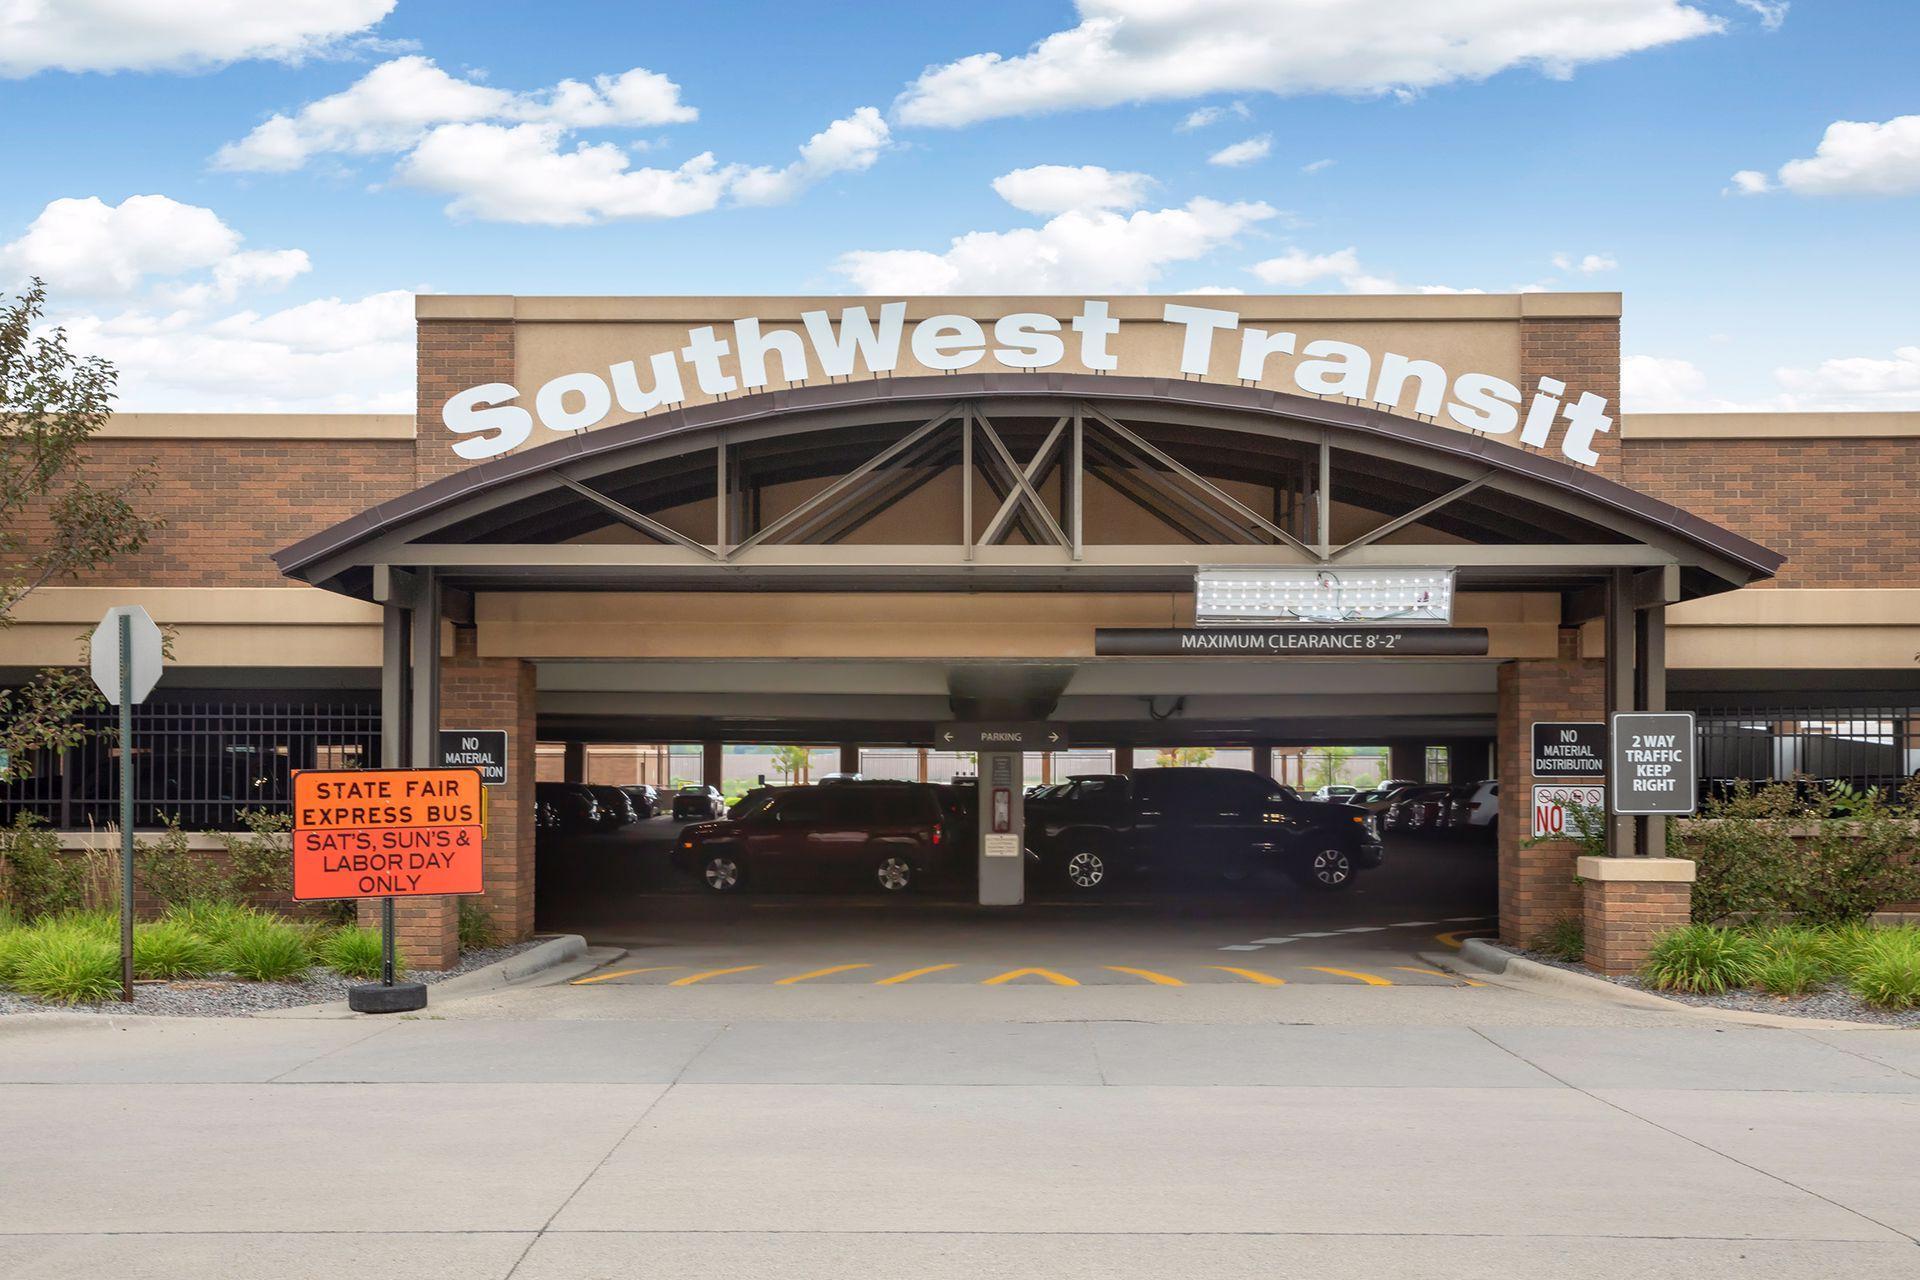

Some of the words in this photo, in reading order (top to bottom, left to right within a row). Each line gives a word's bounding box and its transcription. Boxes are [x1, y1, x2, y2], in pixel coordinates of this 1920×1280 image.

[442, 300, 1120, 460] SouthWest
[1163, 303, 1613, 467] Transit
[1181, 634, 1264, 649] MAXIMUM
[1268, 634, 1362, 649] CLEARANCE
[981, 732, 1022, 742] PARKING
[1560, 729, 1577, 743] NO
[1631, 735, 1642, 748] 2
[1643, 735, 1676, 748] WAY
[462, 737, 479, 750] NO
[1544, 745, 1594, 757] MATERIAL
[1625, 749, 1682, 763] TRAFFIC
[445, 753, 495, 764] MATERIAL
[1536, 758, 1603, 771] DISTRIBUTION
[1636, 764, 1672, 777] KEEP
[317, 781, 392, 799] STATE
[406, 780, 459, 797] FAIR
[1633, 778, 1676, 791] RIGHT
[303, 806, 412, 825] EXPRESS
[428, 804, 473, 822] BUS
[1536, 804, 1563, 833] NO
[306, 832, 377, 852] SAT'S,
[382, 831, 451, 849] SUN'S
[456, 830, 471, 847] &
[323, 853, 403, 873] LABOR
[409, 852, 455, 870] DAY
[359, 874, 421, 893] ONLY
